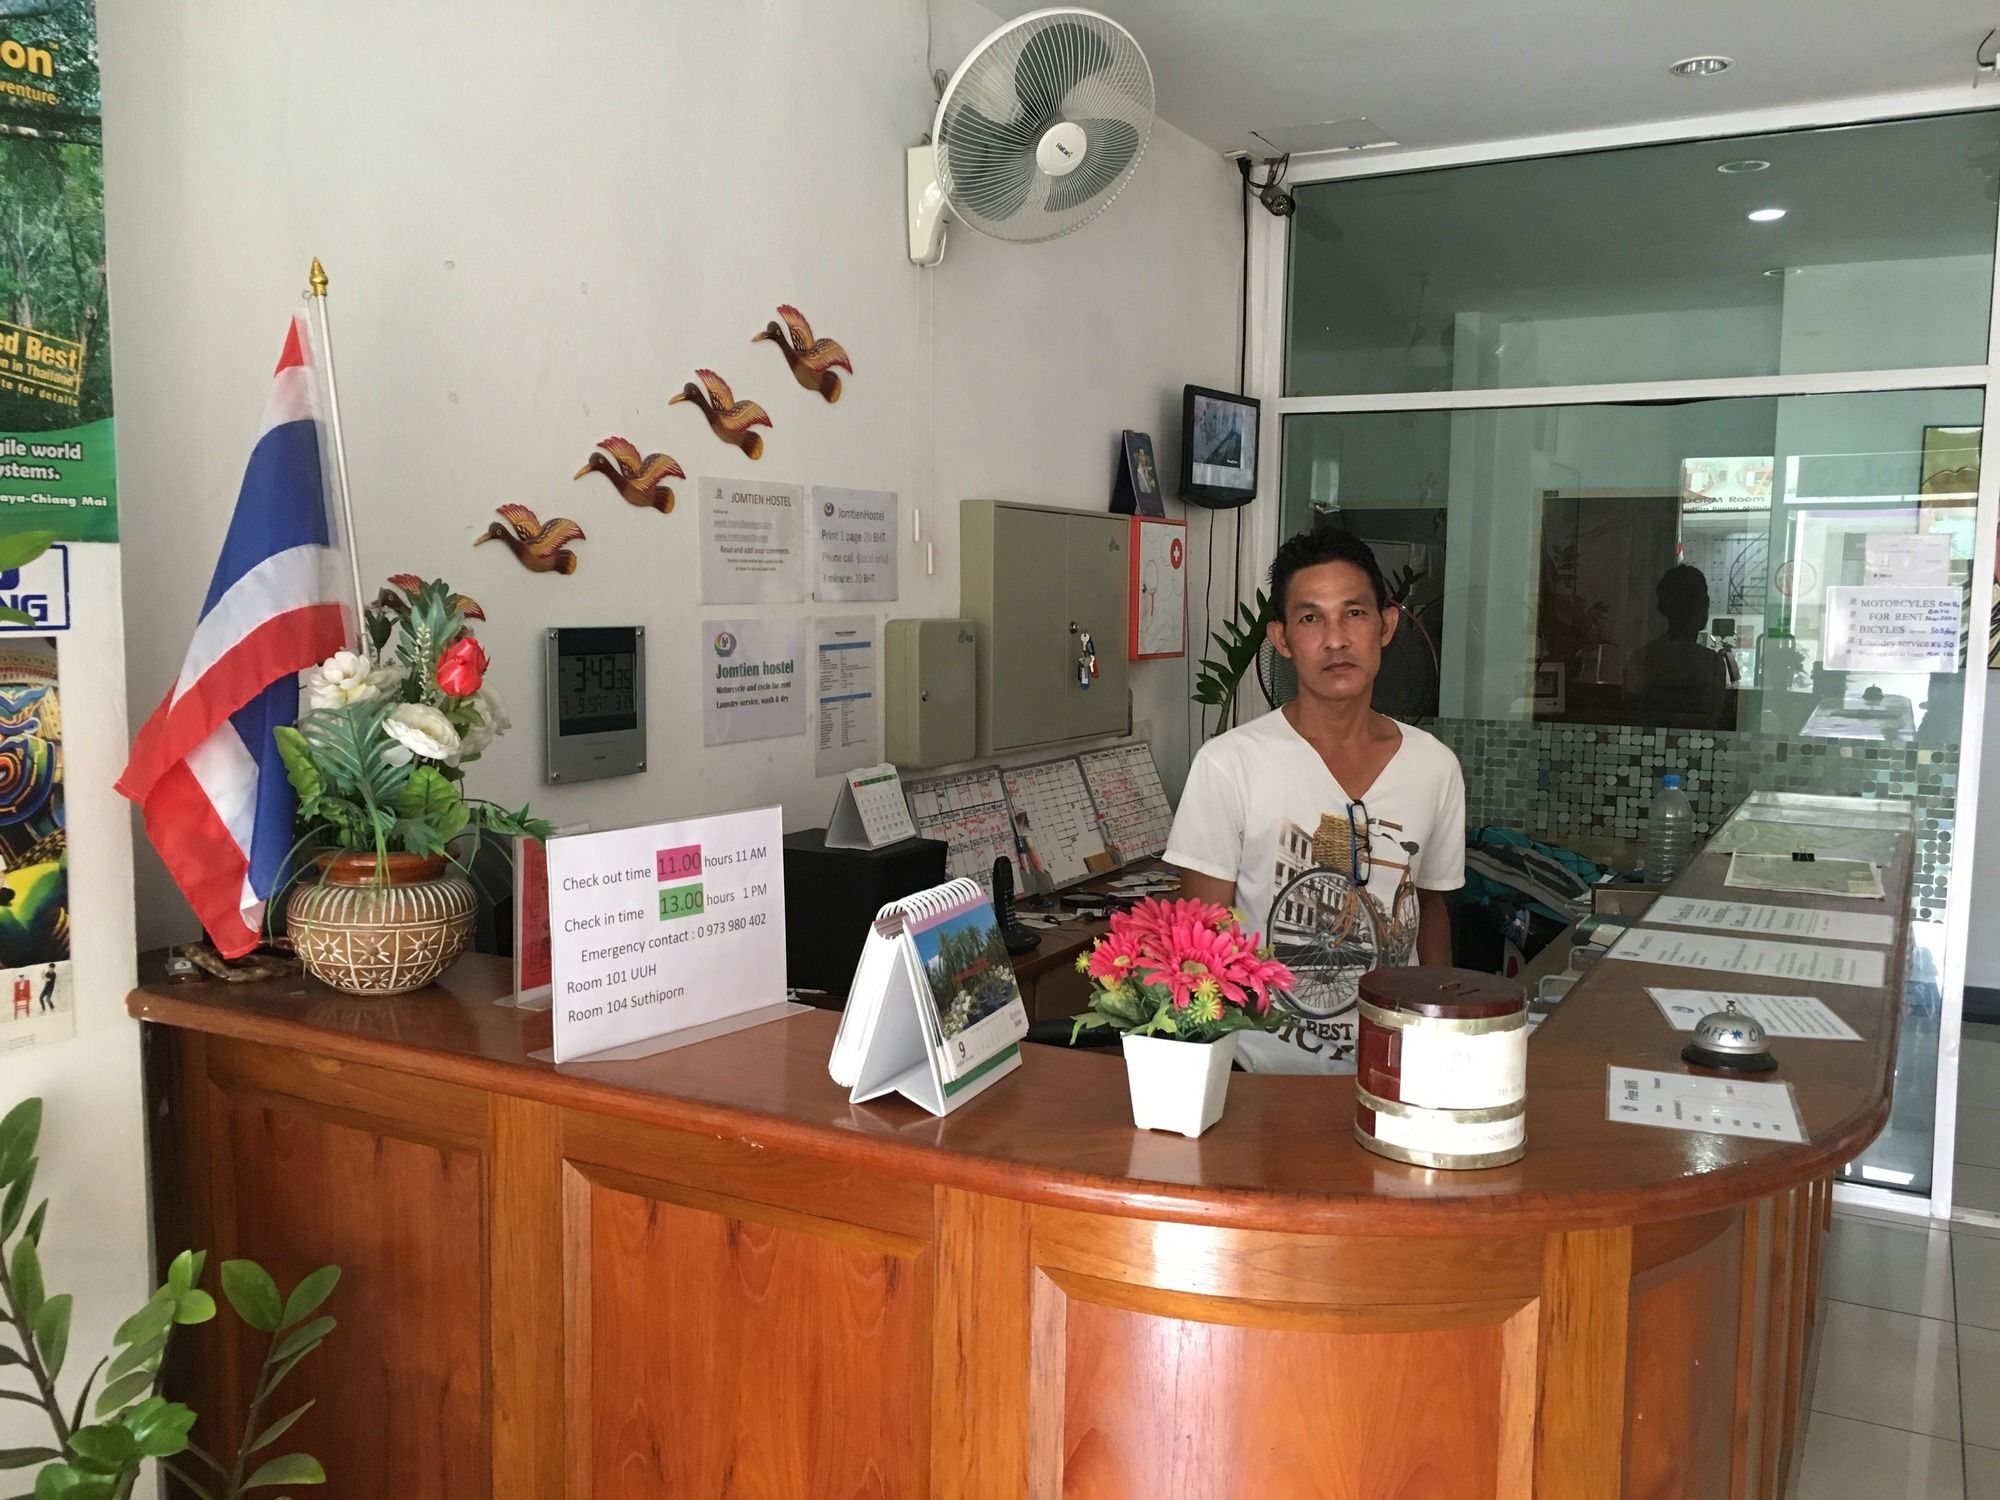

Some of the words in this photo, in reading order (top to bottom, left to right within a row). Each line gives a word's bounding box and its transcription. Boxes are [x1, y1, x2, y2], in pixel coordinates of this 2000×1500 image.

[25, 335, 77, 370] Best
[31, 443, 82, 459] world
[81, 496, 107, 507] Mai
[731, 493, 765, 504] JOMTIEN
[765, 495, 792, 507] HOSTEL
[821, 529, 839, 540] Print
[1861, 599, 1936, 608] MOTORCYLES
[1869, 613, 1890, 621] FOR
[1895, 613, 1923, 621] RENT
[1859, 626, 1905, 634] BICYLES
[716, 663, 760, 679] Jomtien
[762, 659, 794, 675] hostel
[563, 876, 600, 892] Check
[602, 872, 623, 885] out
[625, 865, 652, 881] time
[657, 851, 702, 876] 11.00
[704, 854, 733, 868] hours
[735, 849, 748, 863] 11
[749, 846, 767, 860] AM
[564, 916, 601, 934] Check
[604, 911, 616, 925] in
[618, 906, 645, 924] time
[660, 889, 704, 916] 13.00
[706, 892, 735, 906] hours
[751, 883, 768, 898] PM
[581, 941, 646, 963] Emergency
[648, 929, 689, 948] contact
[697, 924, 705, 938] 0
[706, 921, 726, 937] 973
[728, 917, 747, 933] 980
[748, 913, 767, 926] 402
[567, 978, 603, 994] Room
[606, 970, 627, 987] 101
[630, 963, 657, 980] UUH
[568, 1006, 604, 1023] Room
[607, 998, 628, 1014] 104
[630, 986, 685, 1008] Suthiporn
[1306, 1020, 1354, 1041] BEST
[958, 1041, 966, 1059] 9
